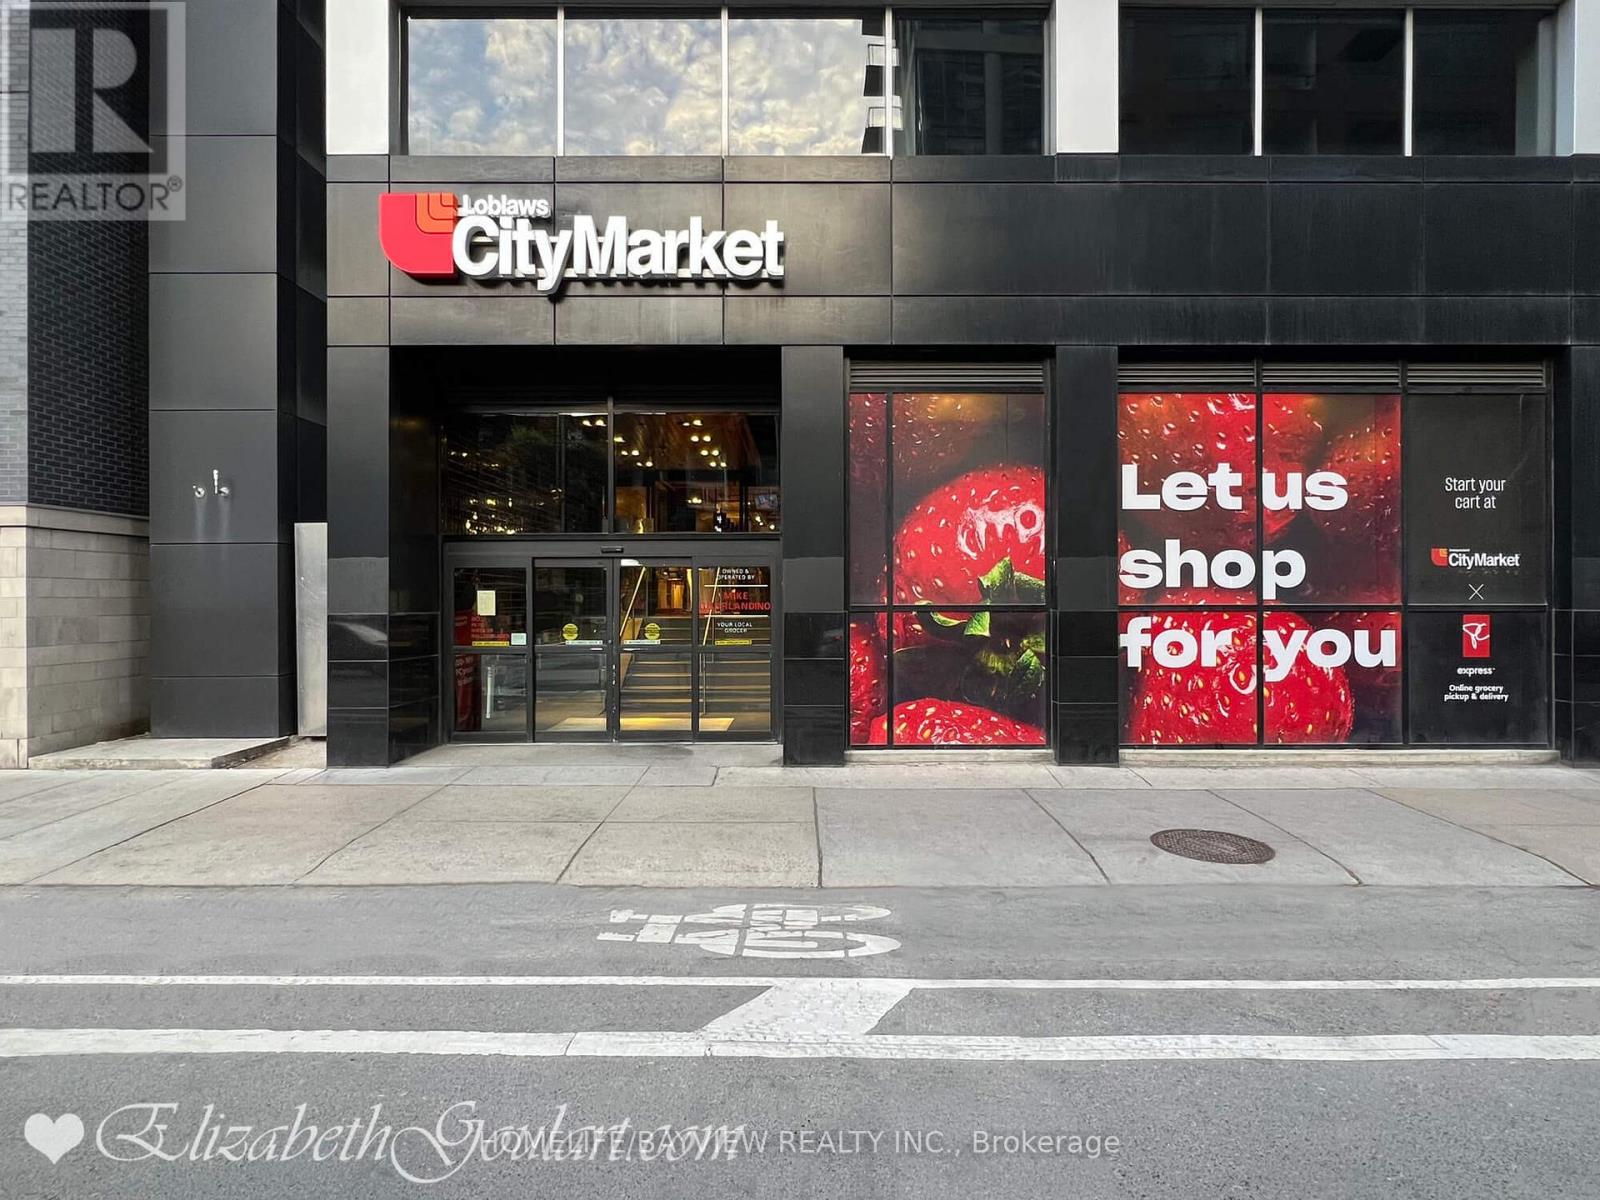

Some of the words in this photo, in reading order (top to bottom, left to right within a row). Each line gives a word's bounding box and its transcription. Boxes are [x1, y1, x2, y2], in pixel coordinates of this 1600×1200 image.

[462, 194, 550, 217] Loblaws
[452, 215, 785, 291] CityMarket
[1121, 463, 1243, 511] Let
[1262, 472, 1349, 511] us
[1445, 477, 1476, 491] Start
[1479, 479, 1506, 494] your
[1455, 495, 1480, 509] cart
[1483, 496, 1496, 509] at
[1119, 539, 1306, 600] shop
[1448, 553, 1520, 570] CityMarket
[723, 591, 749, 600] MIKE
[1119, 616, 1237, 668] for
[1262, 629, 1397, 682] you
[1444, 693, 1469, 702] pickup
[1479, 693, 1509, 702] delivery
[1475, 685, 1504, 694] grocery
